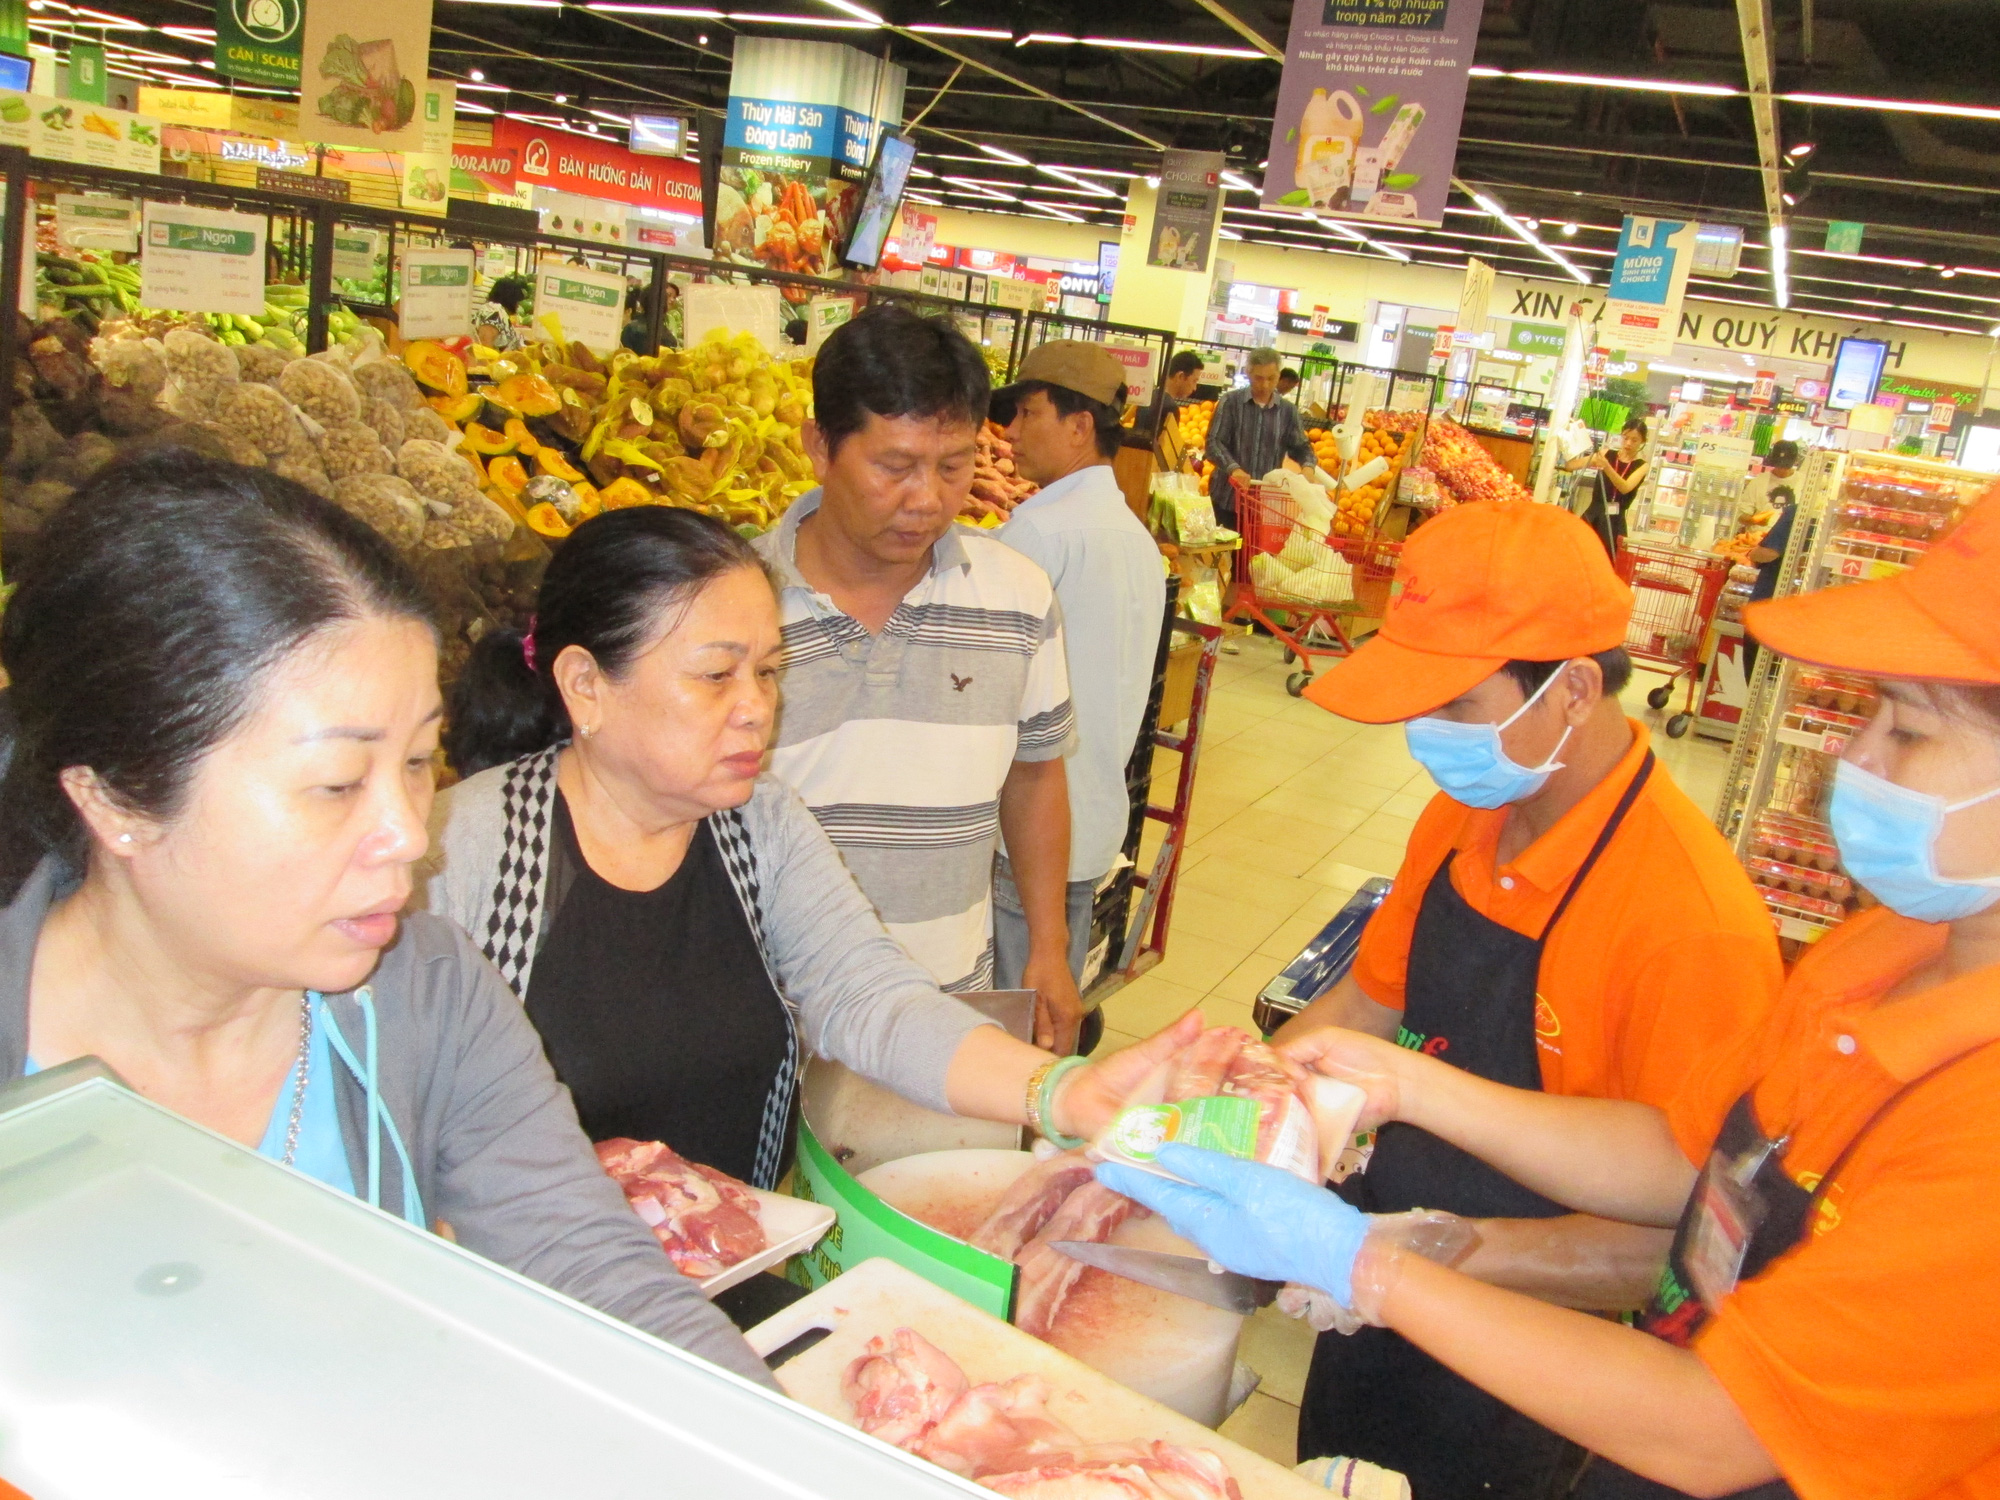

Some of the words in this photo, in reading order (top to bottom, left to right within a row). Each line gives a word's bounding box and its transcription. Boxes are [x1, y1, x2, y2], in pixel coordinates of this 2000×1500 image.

[1336, 10, 1367, 25] trong
[1370, 12, 1397, 24] năm
[1399, 13, 1432, 26] 2017
[227, 45, 254, 61] CÂN
[261, 53, 299, 70] SCALE
[742, 102, 774, 126] Thủy
[798, 107, 824, 128] Sản
[745, 125, 778, 151] Đông
[780, 129, 813, 151] Lạnh
[740, 152, 774, 167] Frozen
[775, 155, 812, 173] Fishery
[558, 154, 584, 178] BÀN
[587, 161, 627, 187] HƯỚNG
[629, 167, 653, 192] DẪN
[664, 180, 702, 203] CUSTOM
[1165, 170, 1203, 183] CHOICE
[1206, 174, 1215, 185] L
[201, 229, 236, 246] Ngon
[1623, 255, 1663, 270] MỪNG
[1620, 274, 1650, 284] CHOICE
[582, 285, 607, 299] Ngon
[1047, 280, 1059, 296] 33
[1291, 319, 1343, 334] TONOLY
[1316, 314, 1326, 328] 31
[1510, 289, 1564, 320] XIN
[1712, 315, 1781, 350] QUÝ
[1790, 326, 1907, 369] KHH
[1534, 334, 1564, 346] YVES
